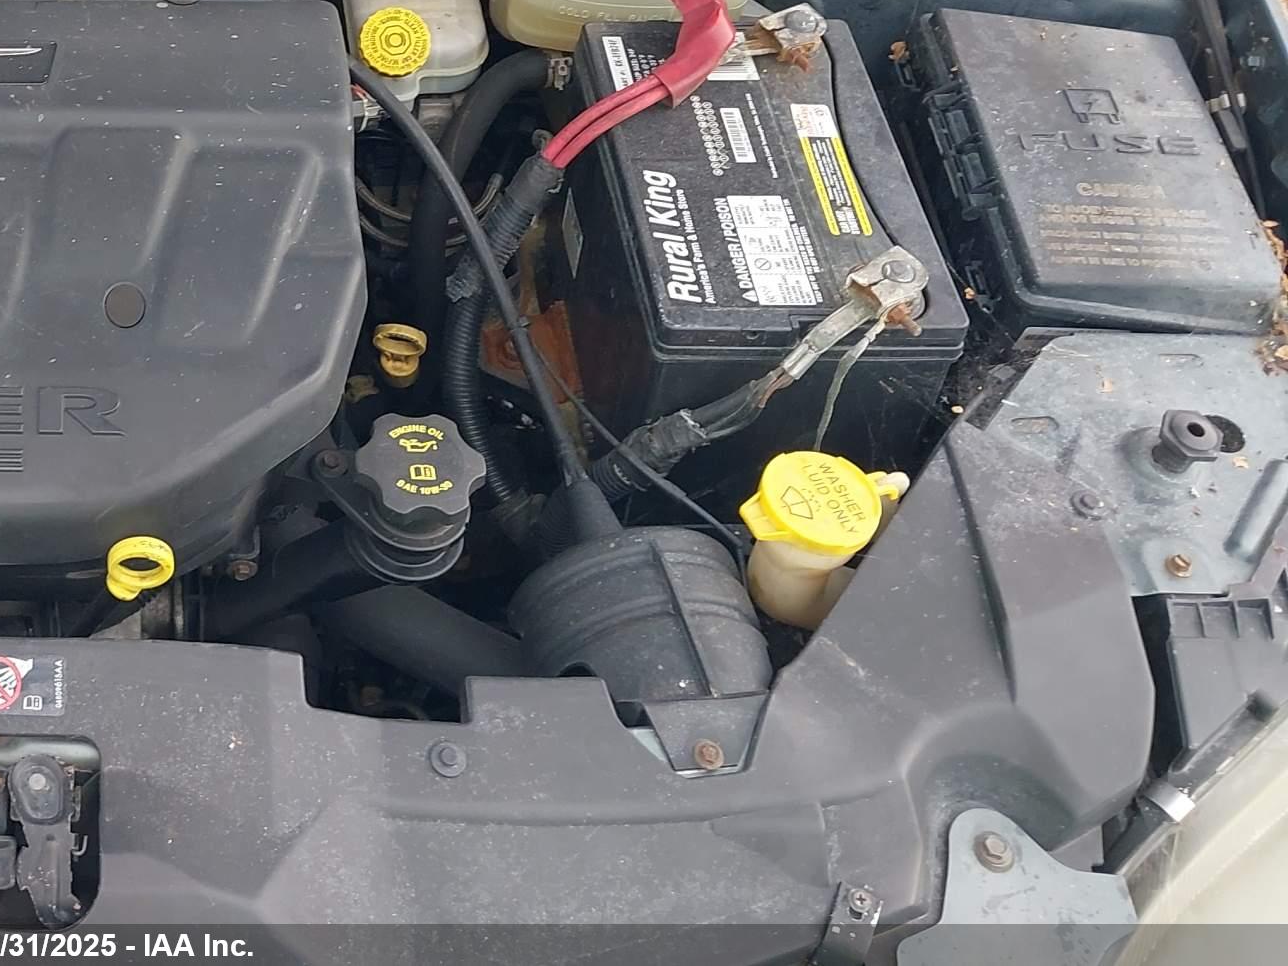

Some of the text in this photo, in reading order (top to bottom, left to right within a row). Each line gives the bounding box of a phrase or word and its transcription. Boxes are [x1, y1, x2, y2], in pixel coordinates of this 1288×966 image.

[1018, 132, 1202, 156] FUSE
[676, 189, 689, 210] Store
[682, 210, 696, 233] Home
[642, 169, 703, 304] Rural King
[691, 241, 704, 263] Farm
[696, 263, 717, 304] America's
[388, 424, 445, 440] ENGINE OIL
[395, 479, 418, 494] SAE
[818, 462, 867, 522] WASHER
[826, 499, 859, 534] ONLY
